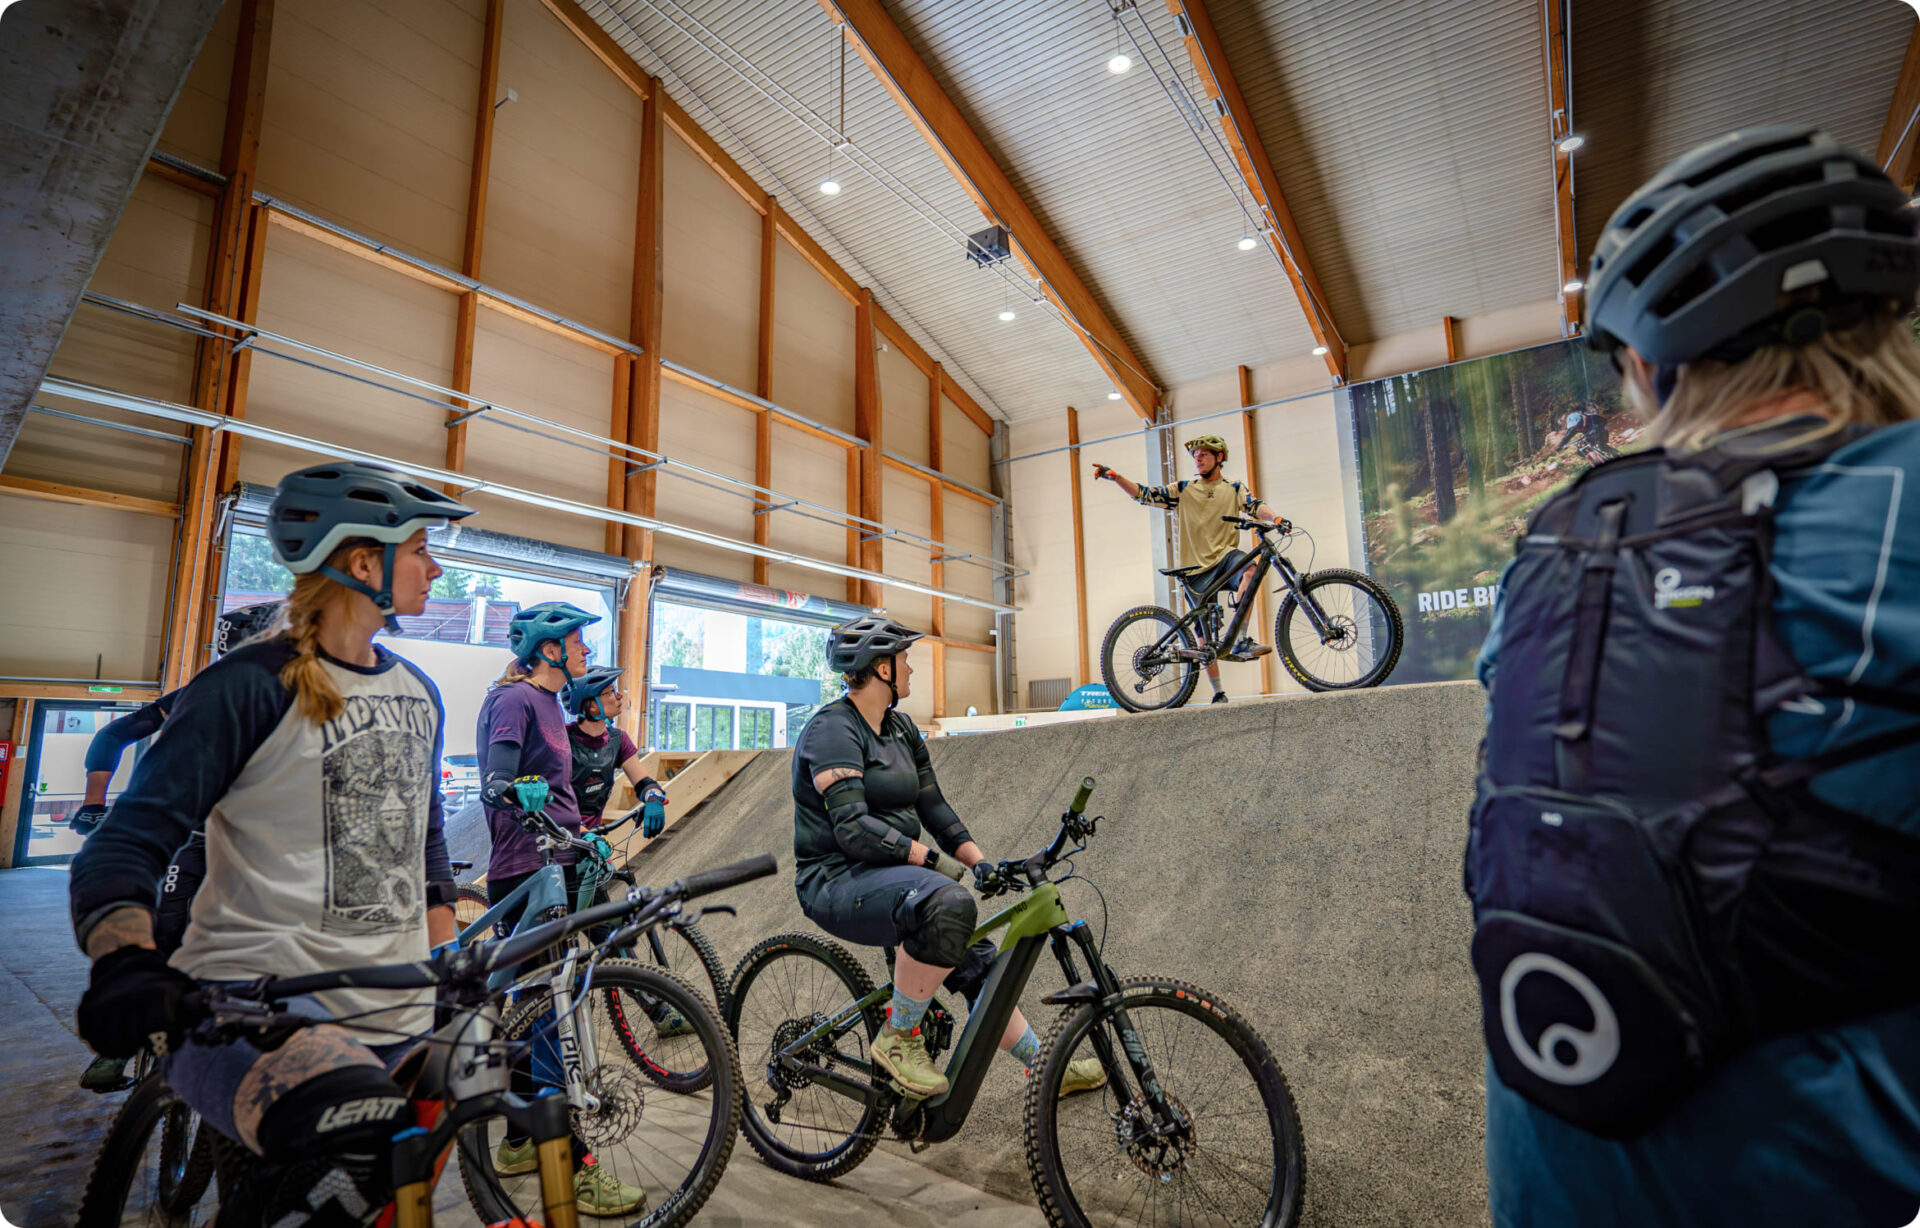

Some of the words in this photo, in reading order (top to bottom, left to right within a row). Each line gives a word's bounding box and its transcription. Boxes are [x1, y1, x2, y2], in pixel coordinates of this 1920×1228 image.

[1418, 588, 1469, 612] RIDE
[560, 1037, 581, 1085] PIKE
[316, 1096, 407, 1133] LEATT
[640, 1212, 657, 1228] DT
[658, 1187, 685, 1216] SWISS
